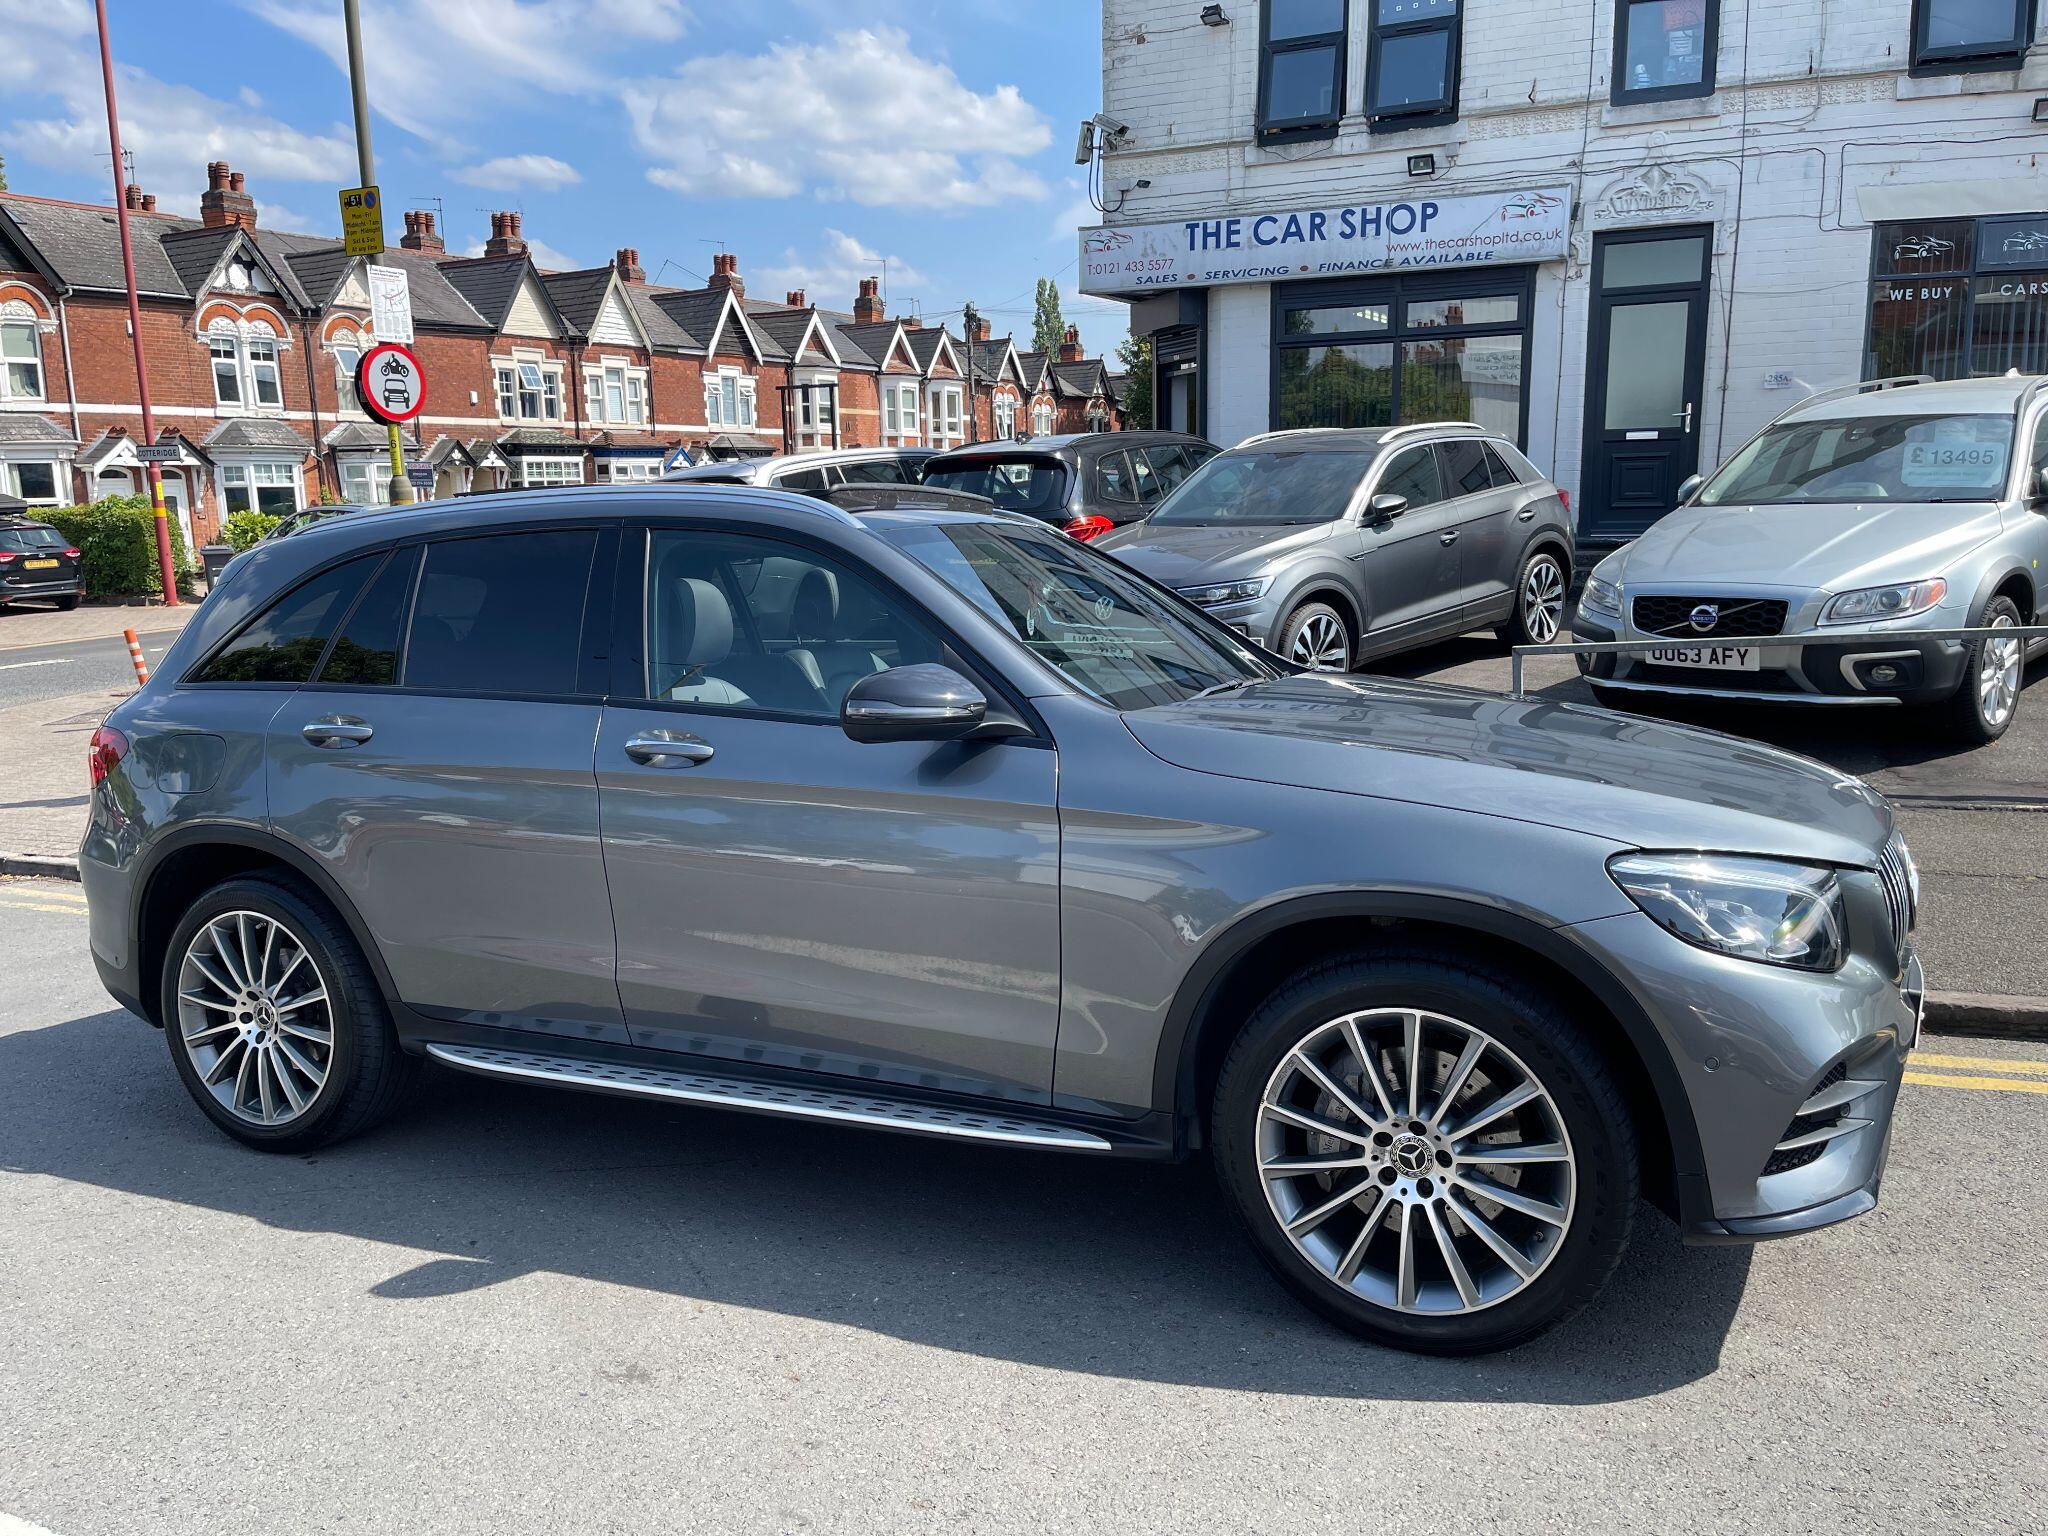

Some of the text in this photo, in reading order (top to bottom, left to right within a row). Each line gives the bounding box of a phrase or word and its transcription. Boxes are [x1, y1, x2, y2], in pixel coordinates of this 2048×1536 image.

[1186, 202, 1439, 251] THE CAR SHOP
[1386, 228, 1562, 253] www.thecarshopltd.co.uk
[1125, 261, 1144, 273] 433
[1148, 259, 1174, 271] 5577
[1136, 251, 1494, 285] SALES SERVICING FINANCE AVAILABLE
[1890, 282, 2048, 301] WE BUY CARS
[138, 449, 177, 457] COTTERIDGE
[1911, 447, 1994, 465] £ 13495
[1709, 647, 1749, 666] AFY
